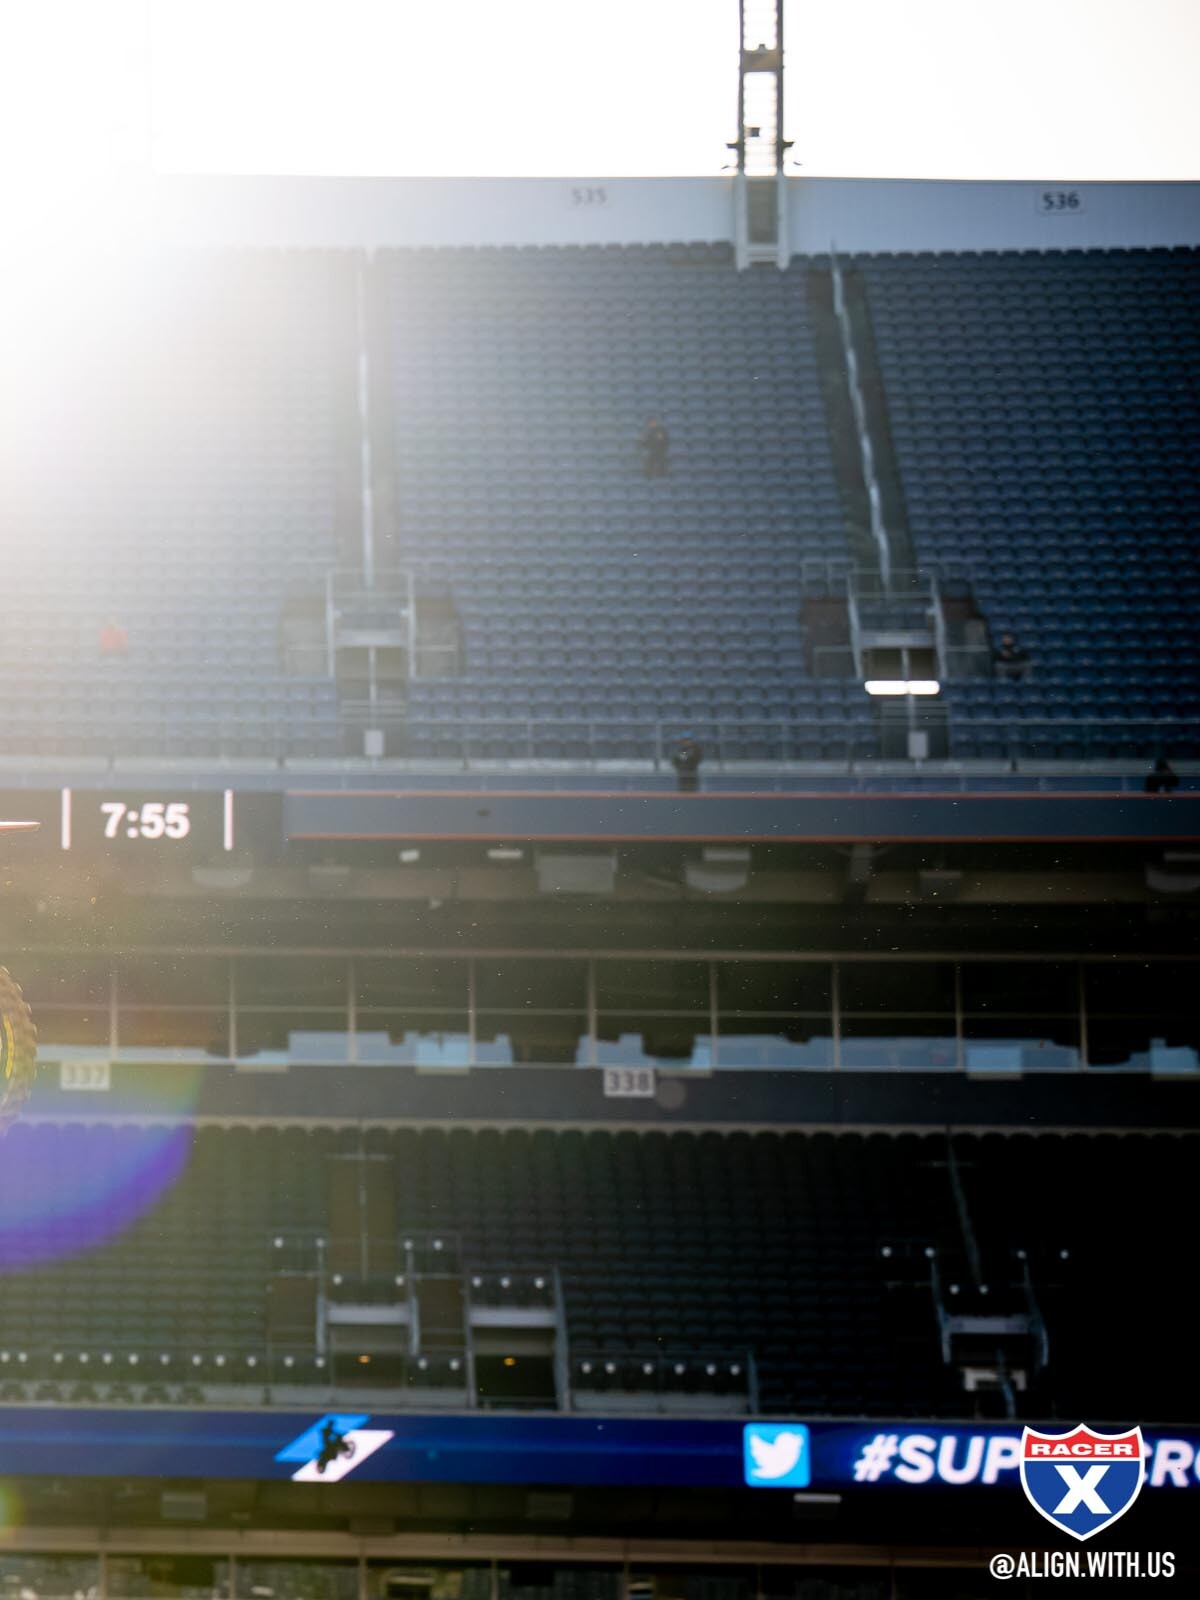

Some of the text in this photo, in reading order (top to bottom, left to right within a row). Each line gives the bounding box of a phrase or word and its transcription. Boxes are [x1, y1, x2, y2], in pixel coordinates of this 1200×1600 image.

[1042, 192, 1080, 211] 536
[101, 803, 190, 838] 7:55
[606, 1072, 649, 1092] 338
